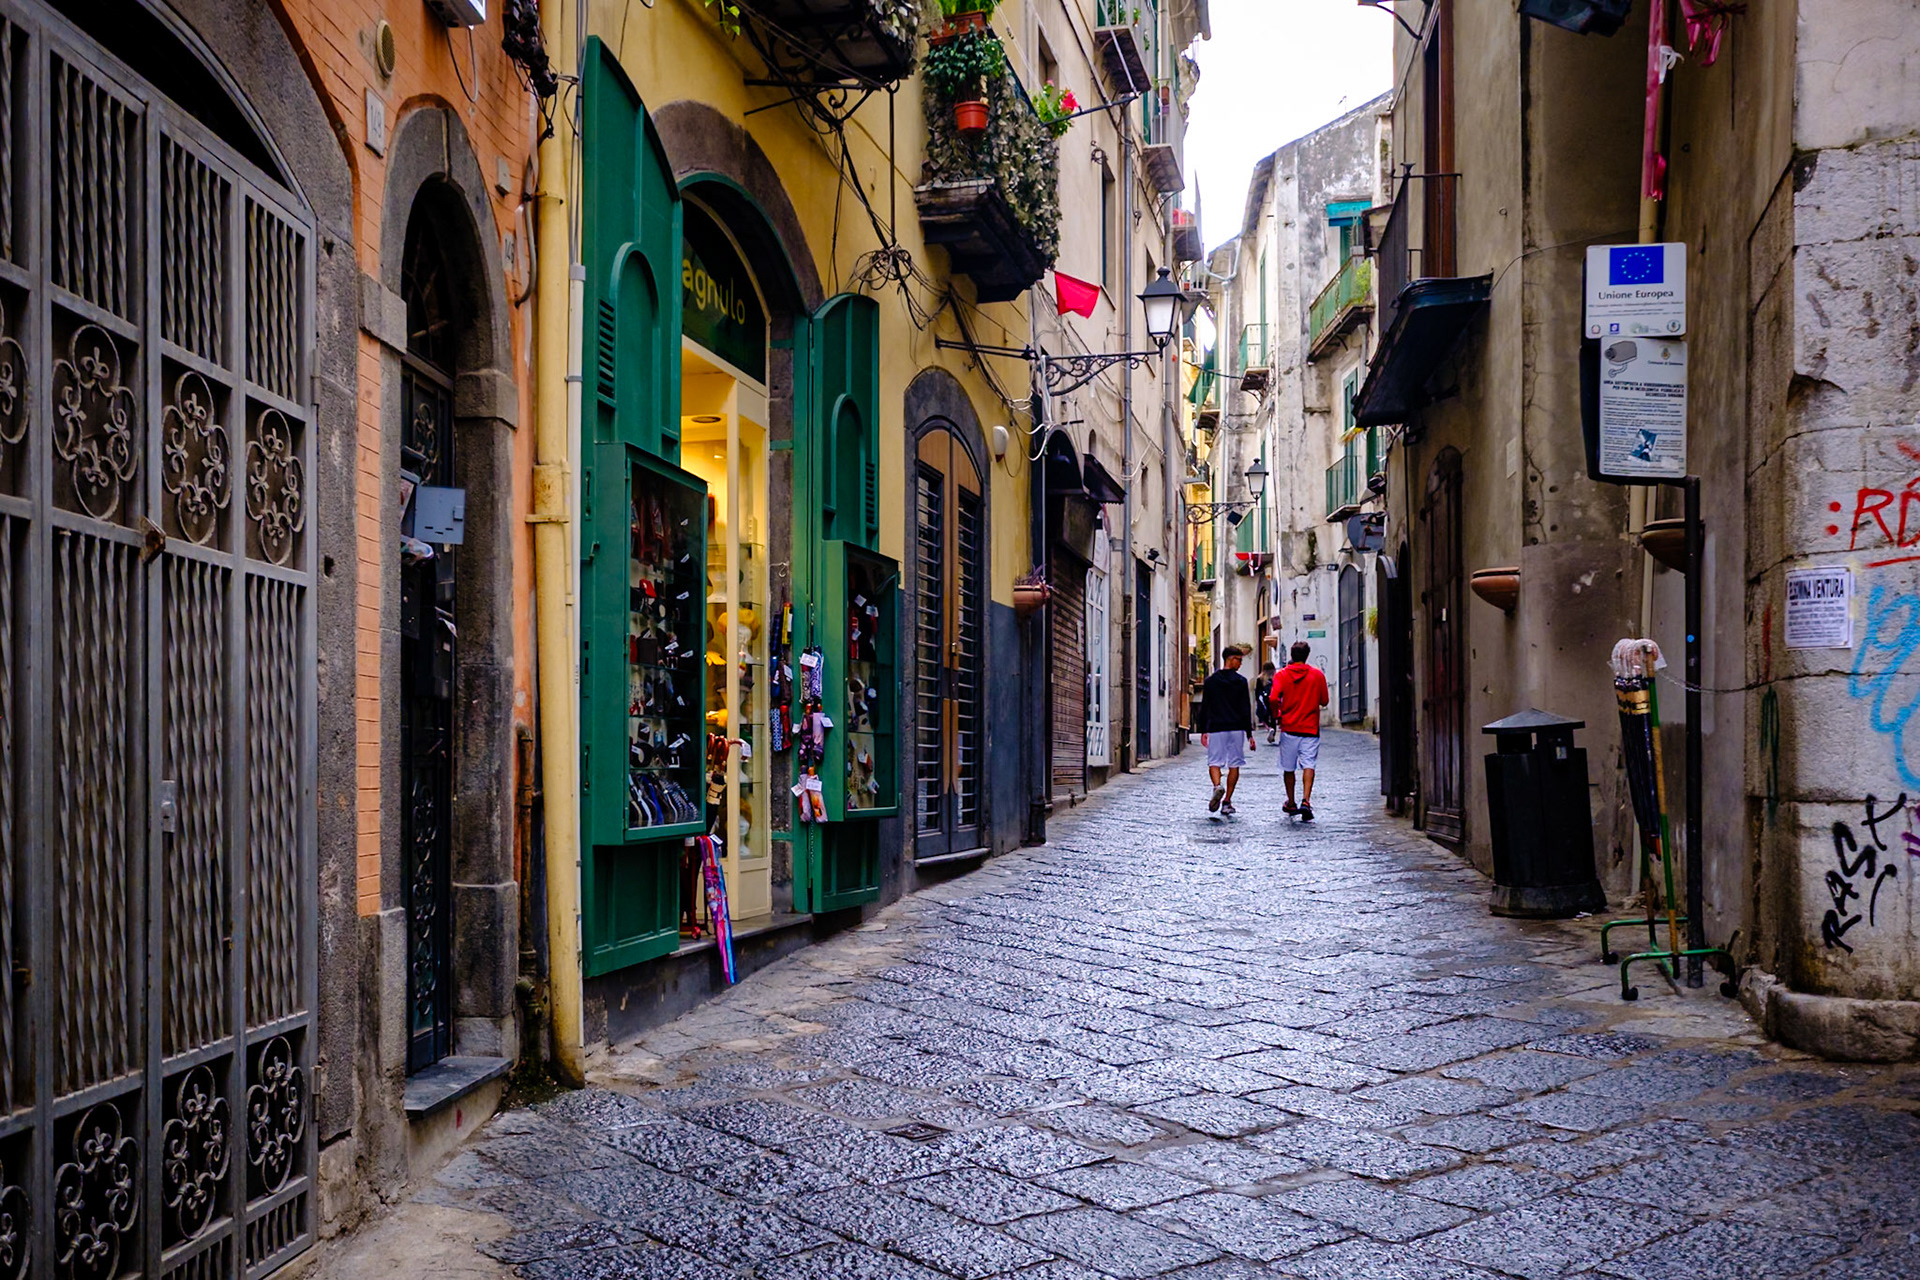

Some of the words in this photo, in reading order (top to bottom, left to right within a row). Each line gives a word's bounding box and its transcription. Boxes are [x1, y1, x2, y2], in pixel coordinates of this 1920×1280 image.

[1598, 290, 1633, 300] Unione
[1635, 290, 1674, 300] Europea
[1811, 578, 1845, 598] VENTURA
